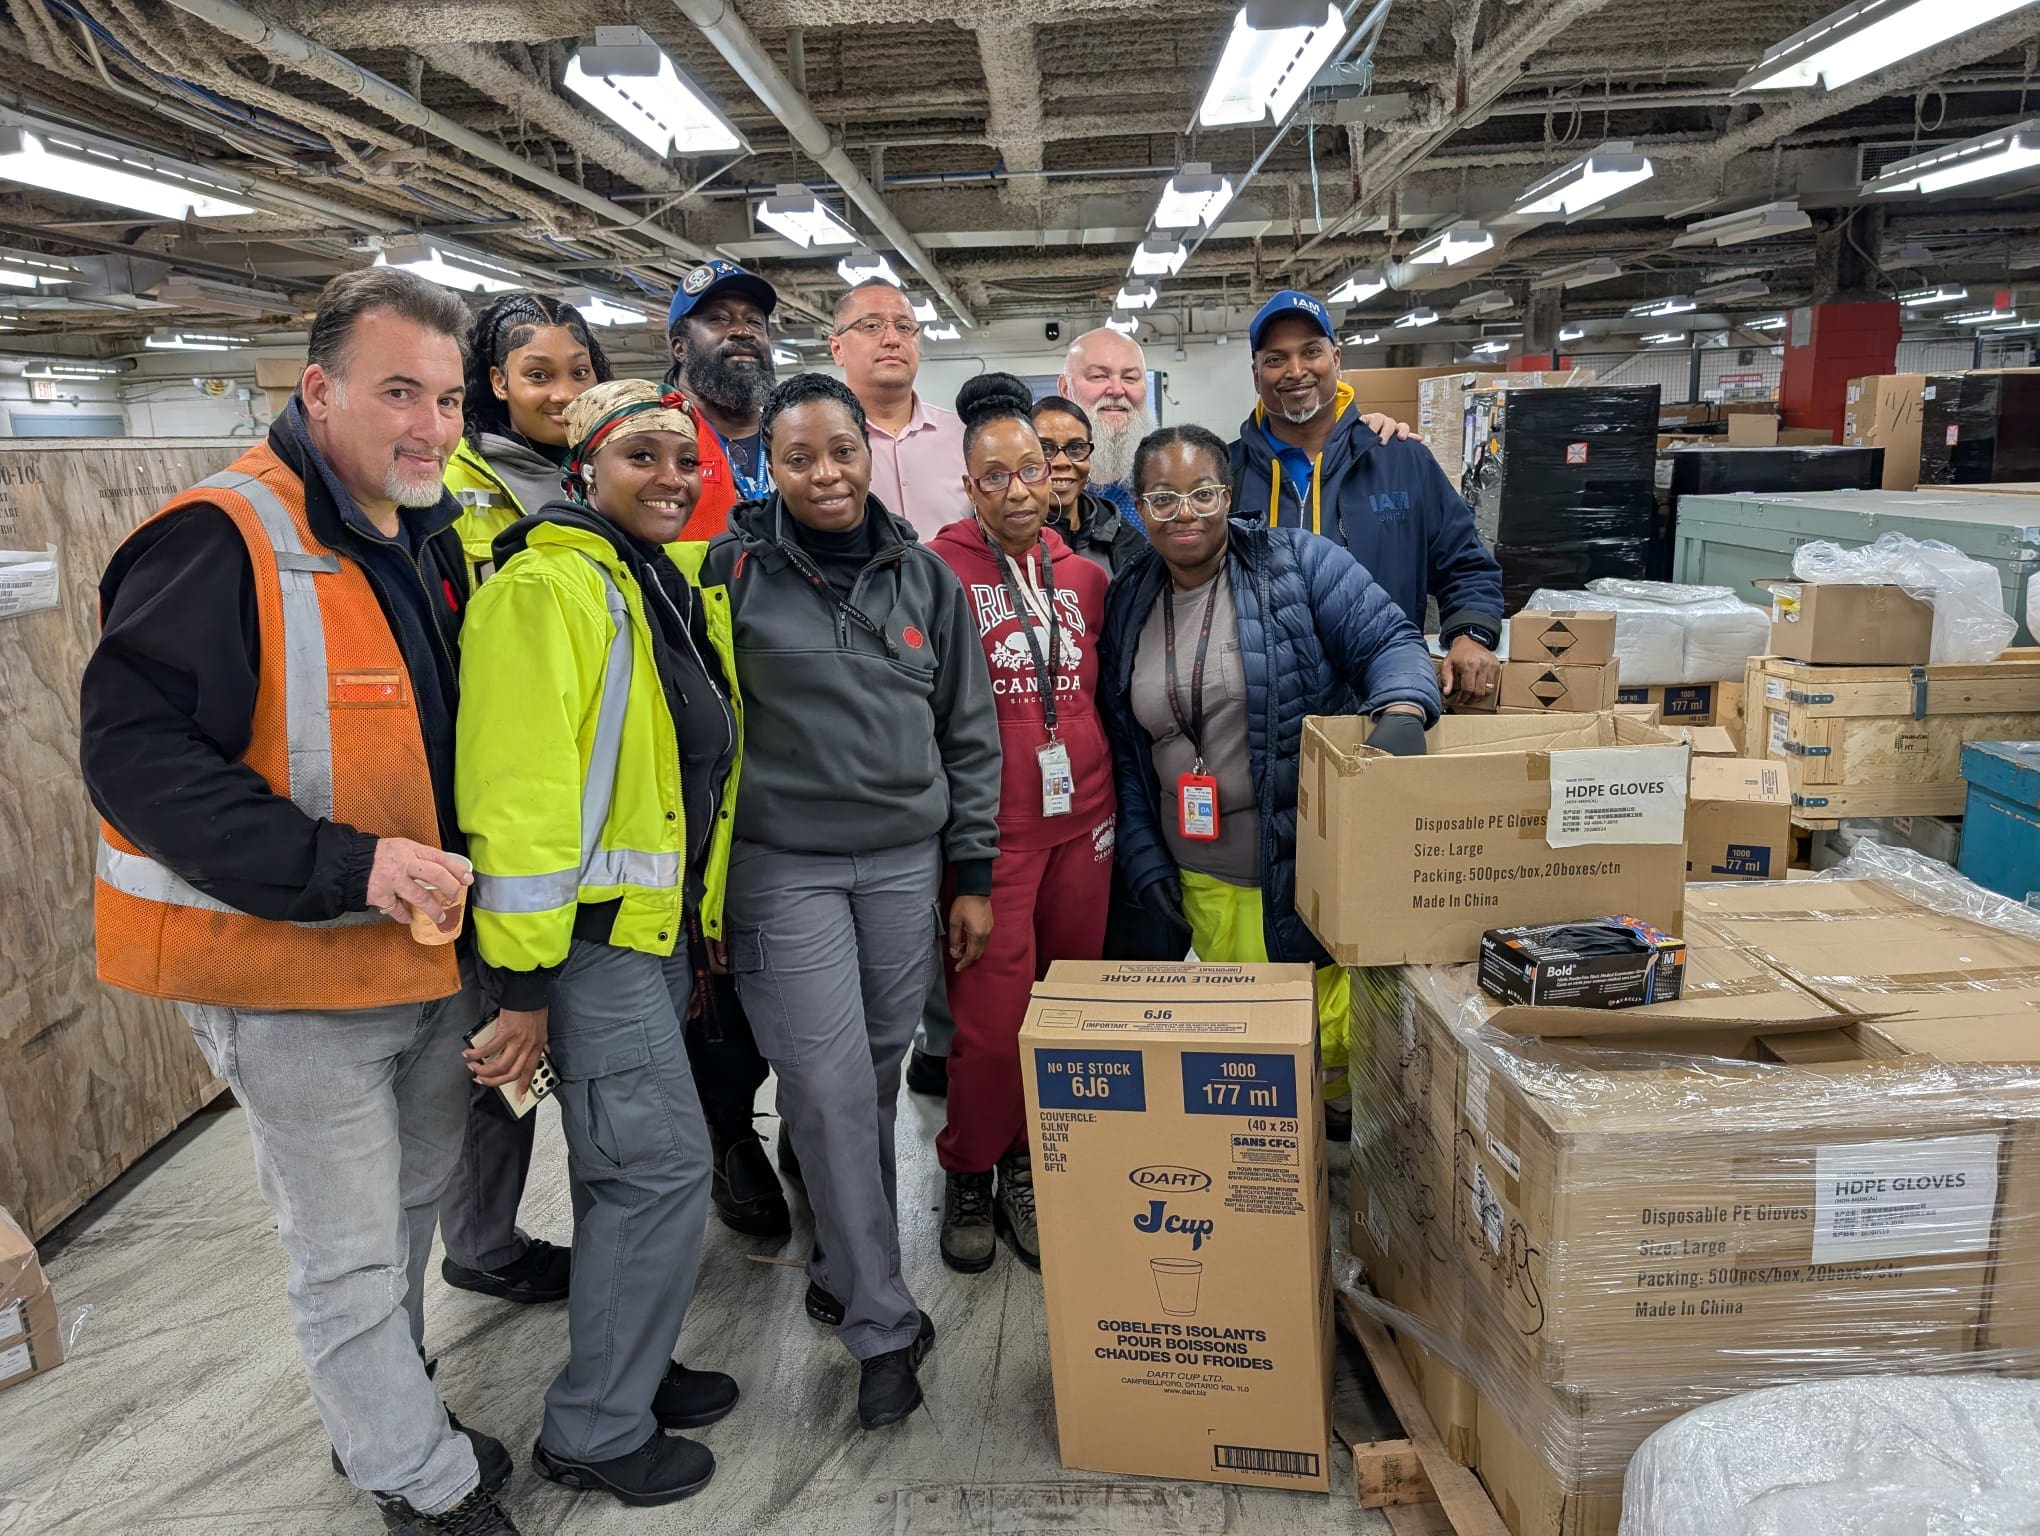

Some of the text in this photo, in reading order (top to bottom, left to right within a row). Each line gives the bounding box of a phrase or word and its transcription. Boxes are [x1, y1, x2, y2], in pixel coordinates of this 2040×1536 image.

[1293, 297, 1320, 312] IAM
[992, 675, 1081, 695] CANDA
[1672, 700, 1703, 711] 177 ml
[1565, 781, 1664, 798] HDPE GLOVES
[1415, 816, 1484, 833] Disposable
[1488, 815, 1503, 829] PE
[1507, 814, 1547, 828] Gloves
[1414, 842, 1484, 858] Size: Large
[1732, 849, 1751, 858] 1000
[1413, 861, 1621, 885] Packing: 500pcs/box,20boxes/ctn
[1745, 861, 1760, 871] ml
[1412, 893, 1498, 909] Made In China
[1663, 952, 1675, 965] M
[1100, 974, 1255, 984] HANDLE WITH CARE
[1143, 1009, 1172, 1020] 6J6
[1067, 1062, 1084, 1074] DE
[1088, 1062, 1131, 1076] STOCK
[1220, 1062, 1256, 1078] 1000
[1072, 1076, 1110, 1098] 6J6
[1203, 1084, 1278, 1107] 177 ml
[1040, 1111, 1097, 1123] COUVERCLE:
[1041, 1122, 1069, 1132] 6JLNV
[1248, 1117, 1299, 1134] (40 x 25)
[1233, 1136, 1296, 1148] SANS CFCs
[1043, 1153, 1067, 1163] 6CLR
[1139, 1171, 1202, 1186] DART
[1836, 1172, 1966, 1195] HDPE GLOVES
[1642, 1203, 1808, 1228] Disposable PE Gloves
[1683, 1238, 1727, 1257] Large
[1637, 1269, 1703, 1289] Packing:
[1635, 1299, 1743, 1317] Made In China
[1097, 1319, 1267, 1343] GOBELETS ISOLANTS
[1117, 1334, 1248, 1355] POUR BOISSONS
[1094, 1347, 1274, 1371] CHAUDES OU FROIDES
[1146, 1370, 1224, 1383] DART CUP LTD.
[1163, 1388, 1207, 1397] www.dart.biz
[1184, 1381, 1219, 1391] ONTARIO
